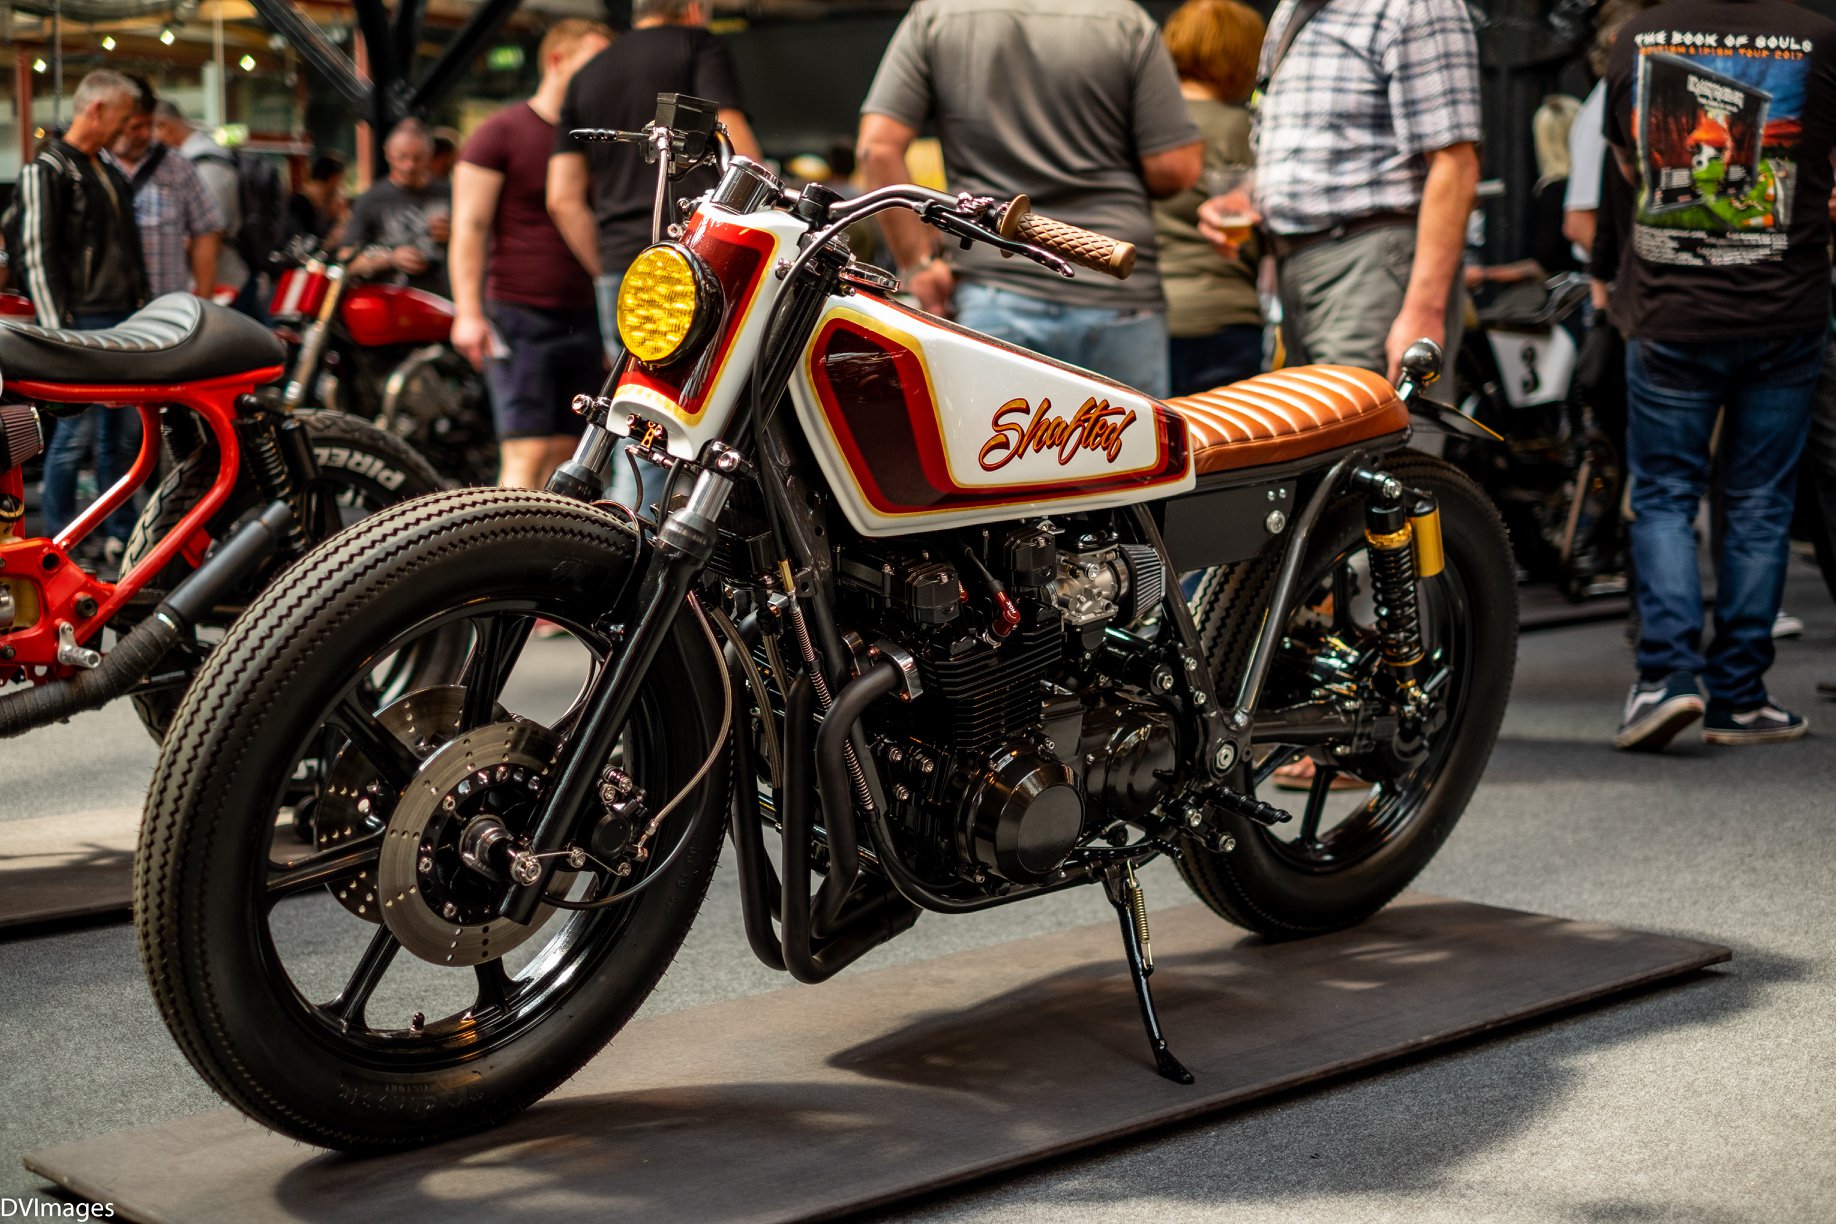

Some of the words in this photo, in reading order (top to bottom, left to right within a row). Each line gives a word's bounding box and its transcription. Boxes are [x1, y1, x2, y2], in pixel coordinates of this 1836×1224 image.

[1634, 30, 1667, 47] THE
[1672, 30, 1718, 47] BOOK
[1724, 33, 1749, 48] OF
[1755, 34, 1813, 53] SOULS
[1738, 48, 1770, 59] TOUR
[1774, 50, 1803, 61] 2017
[978, 396, 1137, 472] Shafted
[313, 446, 406, 491] PIREL
